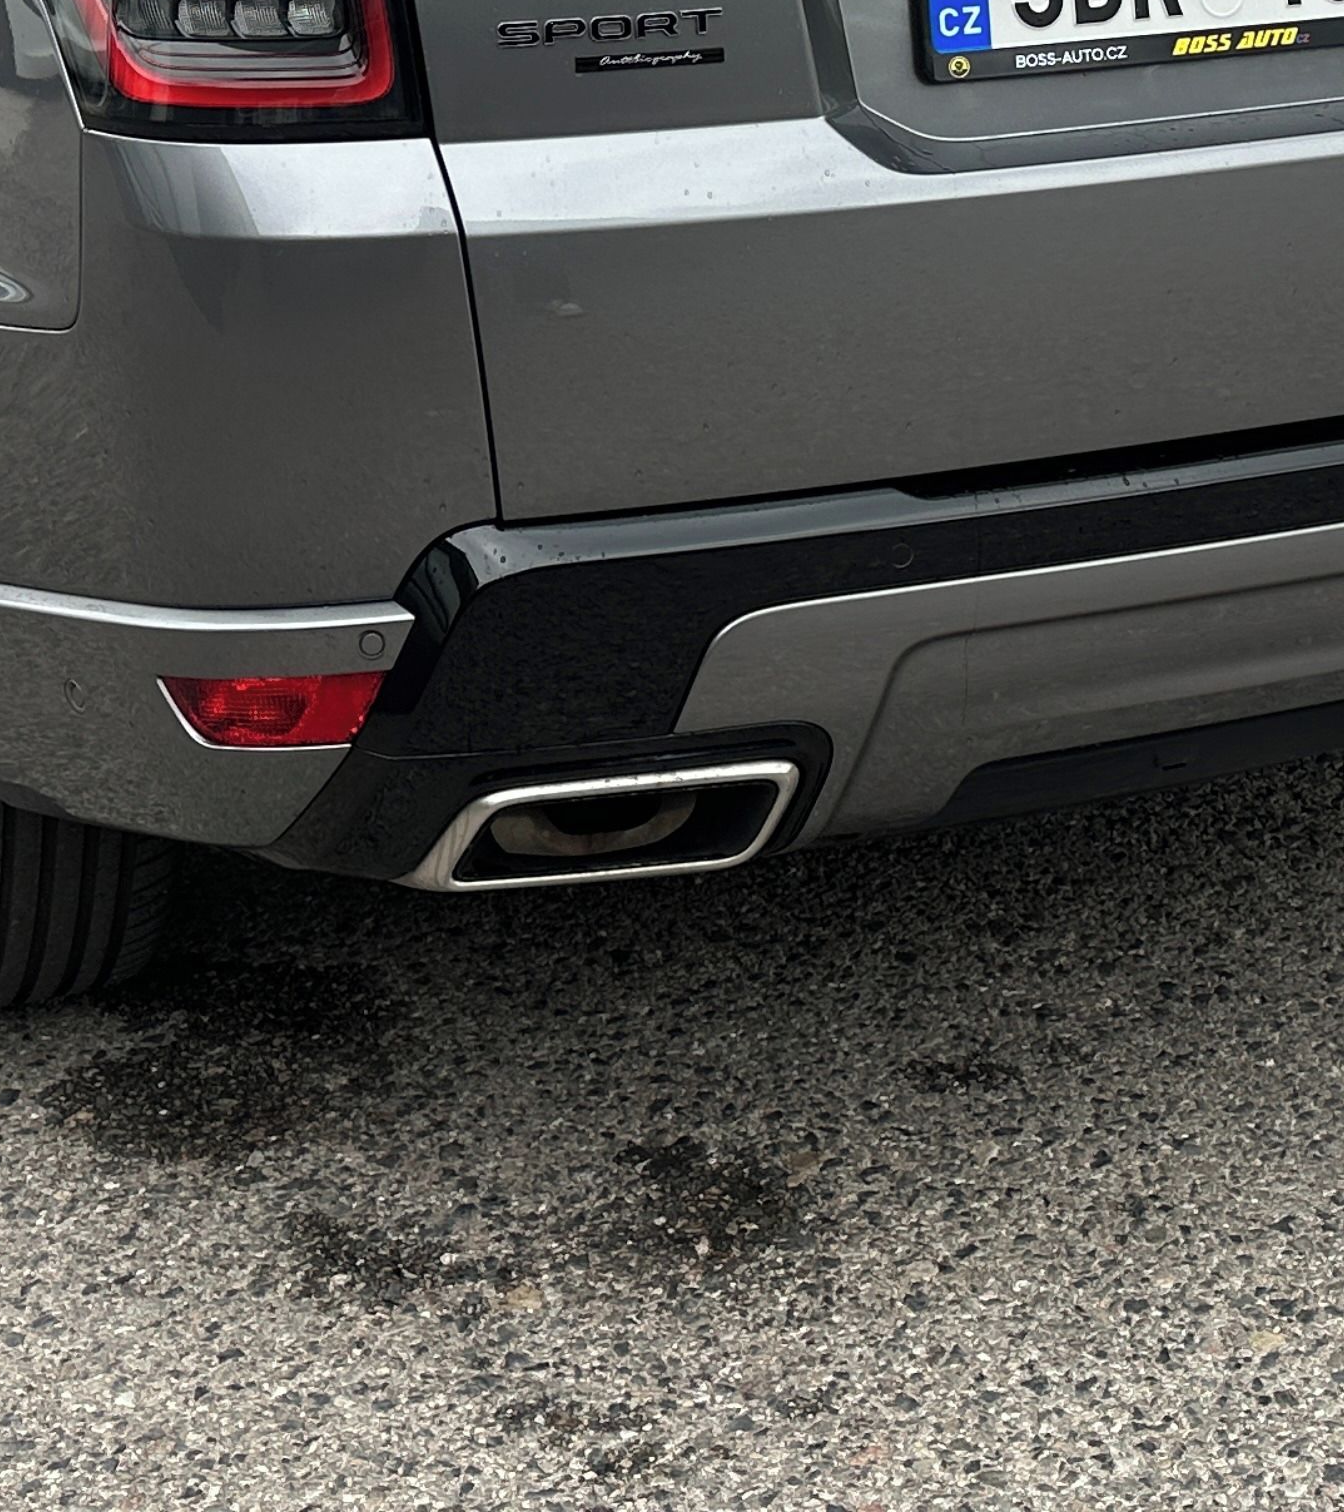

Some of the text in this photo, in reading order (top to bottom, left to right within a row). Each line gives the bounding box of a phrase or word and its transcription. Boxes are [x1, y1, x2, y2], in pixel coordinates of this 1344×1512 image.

[497, 7, 723, 48] SPORT
[938, 6, 983, 37] CZ
[1172, 32, 1231, 56] BOSS
[1235, 26, 1299, 50] AUTO
[1015, 45, 1129, 69] BOSS-AUTO.CZ
